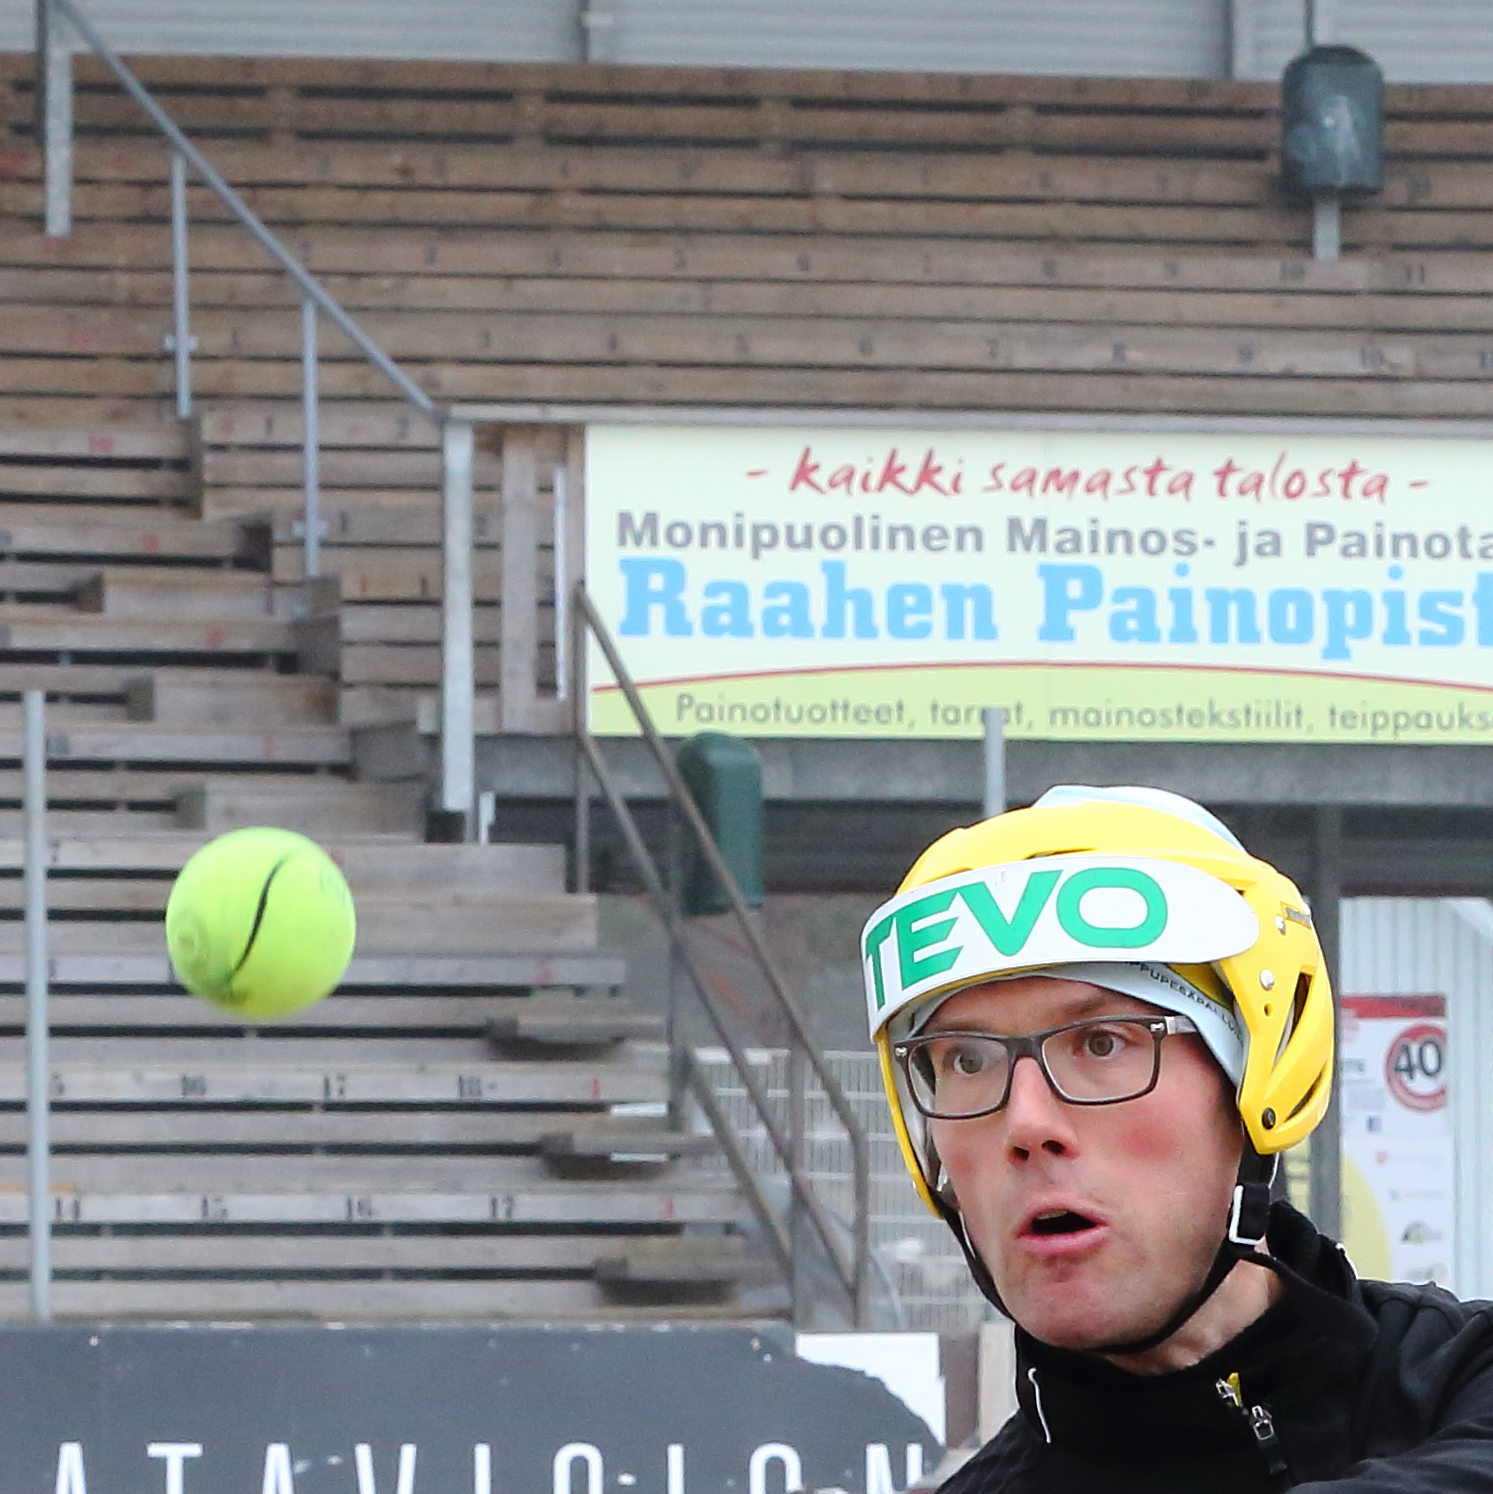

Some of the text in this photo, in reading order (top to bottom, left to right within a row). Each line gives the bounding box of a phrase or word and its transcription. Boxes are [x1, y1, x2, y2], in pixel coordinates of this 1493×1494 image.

[788, 446, 964, 498] kaikki
[981, 458, 1194, 501] samasta
[1214, 452, 1392, 505] talosta
[617, 511, 984, 559] Monipuolinen
[1007, 517, 1217, 559] Mainos-
[1233, 521, 1282, 567] ja
[619, 557, 997, 641] Raahen
[677, 692, 917, 730] Painotuotteet,
[1049, 698, 1316, 735] mainostekstiilit,
[866, 866, 1168, 1012] TEVO
[1393, 1040, 1442, 1081] 40
